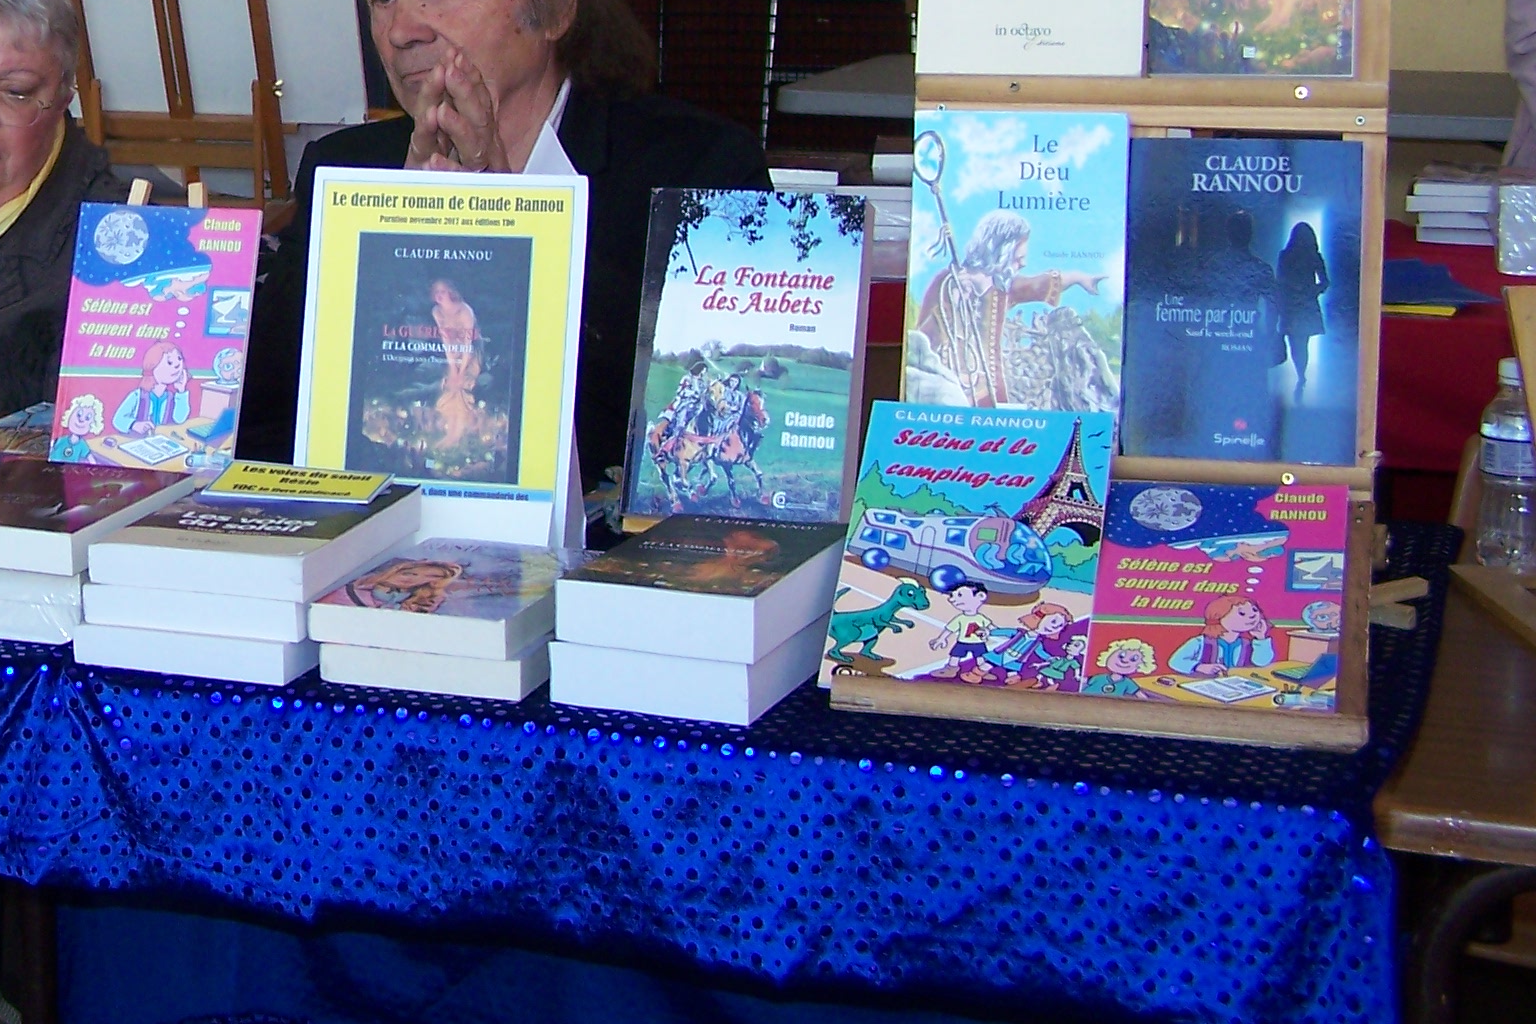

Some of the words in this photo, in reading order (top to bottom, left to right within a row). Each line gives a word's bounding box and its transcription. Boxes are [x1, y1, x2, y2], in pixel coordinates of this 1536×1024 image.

[995, 23, 1007, 36] in
[1010, 22, 1052, 39] octavo
[1033, 134, 1059, 153] Le
[1019, 161, 1069, 181] Dieu
[1205, 155, 1291, 172] CLAUDE
[1191, 173, 1303, 193] RANNOU
[332, 191, 348, 207] Le
[351, 191, 399, 208] dernier
[402, 196, 444, 210] roman
[448, 196, 465, 211] de
[468, 196, 512, 212] Claude
[514, 197, 564, 213] Rannou
[997, 190, 1091, 211] Lumière
[203, 218, 242, 232] Claude
[198, 238, 242, 253] RANNOU
[394, 247, 440, 260] CLAUDE
[443, 249, 493, 262] RANNOU
[694, 264, 727, 286] La
[734, 266, 835, 290] Fontaine
[81, 297, 128, 315] Sélène
[129, 302, 153, 316] est
[702, 287, 739, 311] des
[739, 290, 824, 315] Aubets
[1155, 302, 1202, 323] femme
[1205, 308, 1227, 327] par
[1228, 304, 1257, 329] jour
[78, 322, 133, 337] souvent
[135, 324, 171, 339] dans
[789, 323, 817, 333] Roman
[89, 342, 106, 358] la
[106, 343, 137, 360] lune
[382, 340, 394, 350] ET
[395, 341, 406, 351] LA
[784, 411, 835, 429] Claude
[895, 410, 964, 425] CLAUDE
[970, 416, 1047, 429] RANNOU
[780, 431, 835, 450] Rannou
[893, 428, 976, 451] Sélène
[978, 437, 1007, 453] et
[1008, 438, 1038, 456] le
[1213, 433, 1266, 447] Spinelle
[242, 465, 265, 473] Les
[269, 468, 308, 477] voies
[330, 473, 372, 482] soleil
[885, 462, 1035, 489] camping-car
[1274, 493, 1325, 504] Claude
[181, 511, 232, 522] Les
[240, 516, 317, 527] voies
[1270, 509, 1327, 521] RANNOU
[178, 519, 219, 528] du
[222, 522, 304, 533] soleil
[1116, 557, 1180, 573] Sélène
[1182, 561, 1213, 574] est
[1114, 577, 1190, 592] souvent
[1192, 580, 1240, 594] dans
[1130, 594, 1150, 608] la
[1152, 596, 1196, 610] lune
